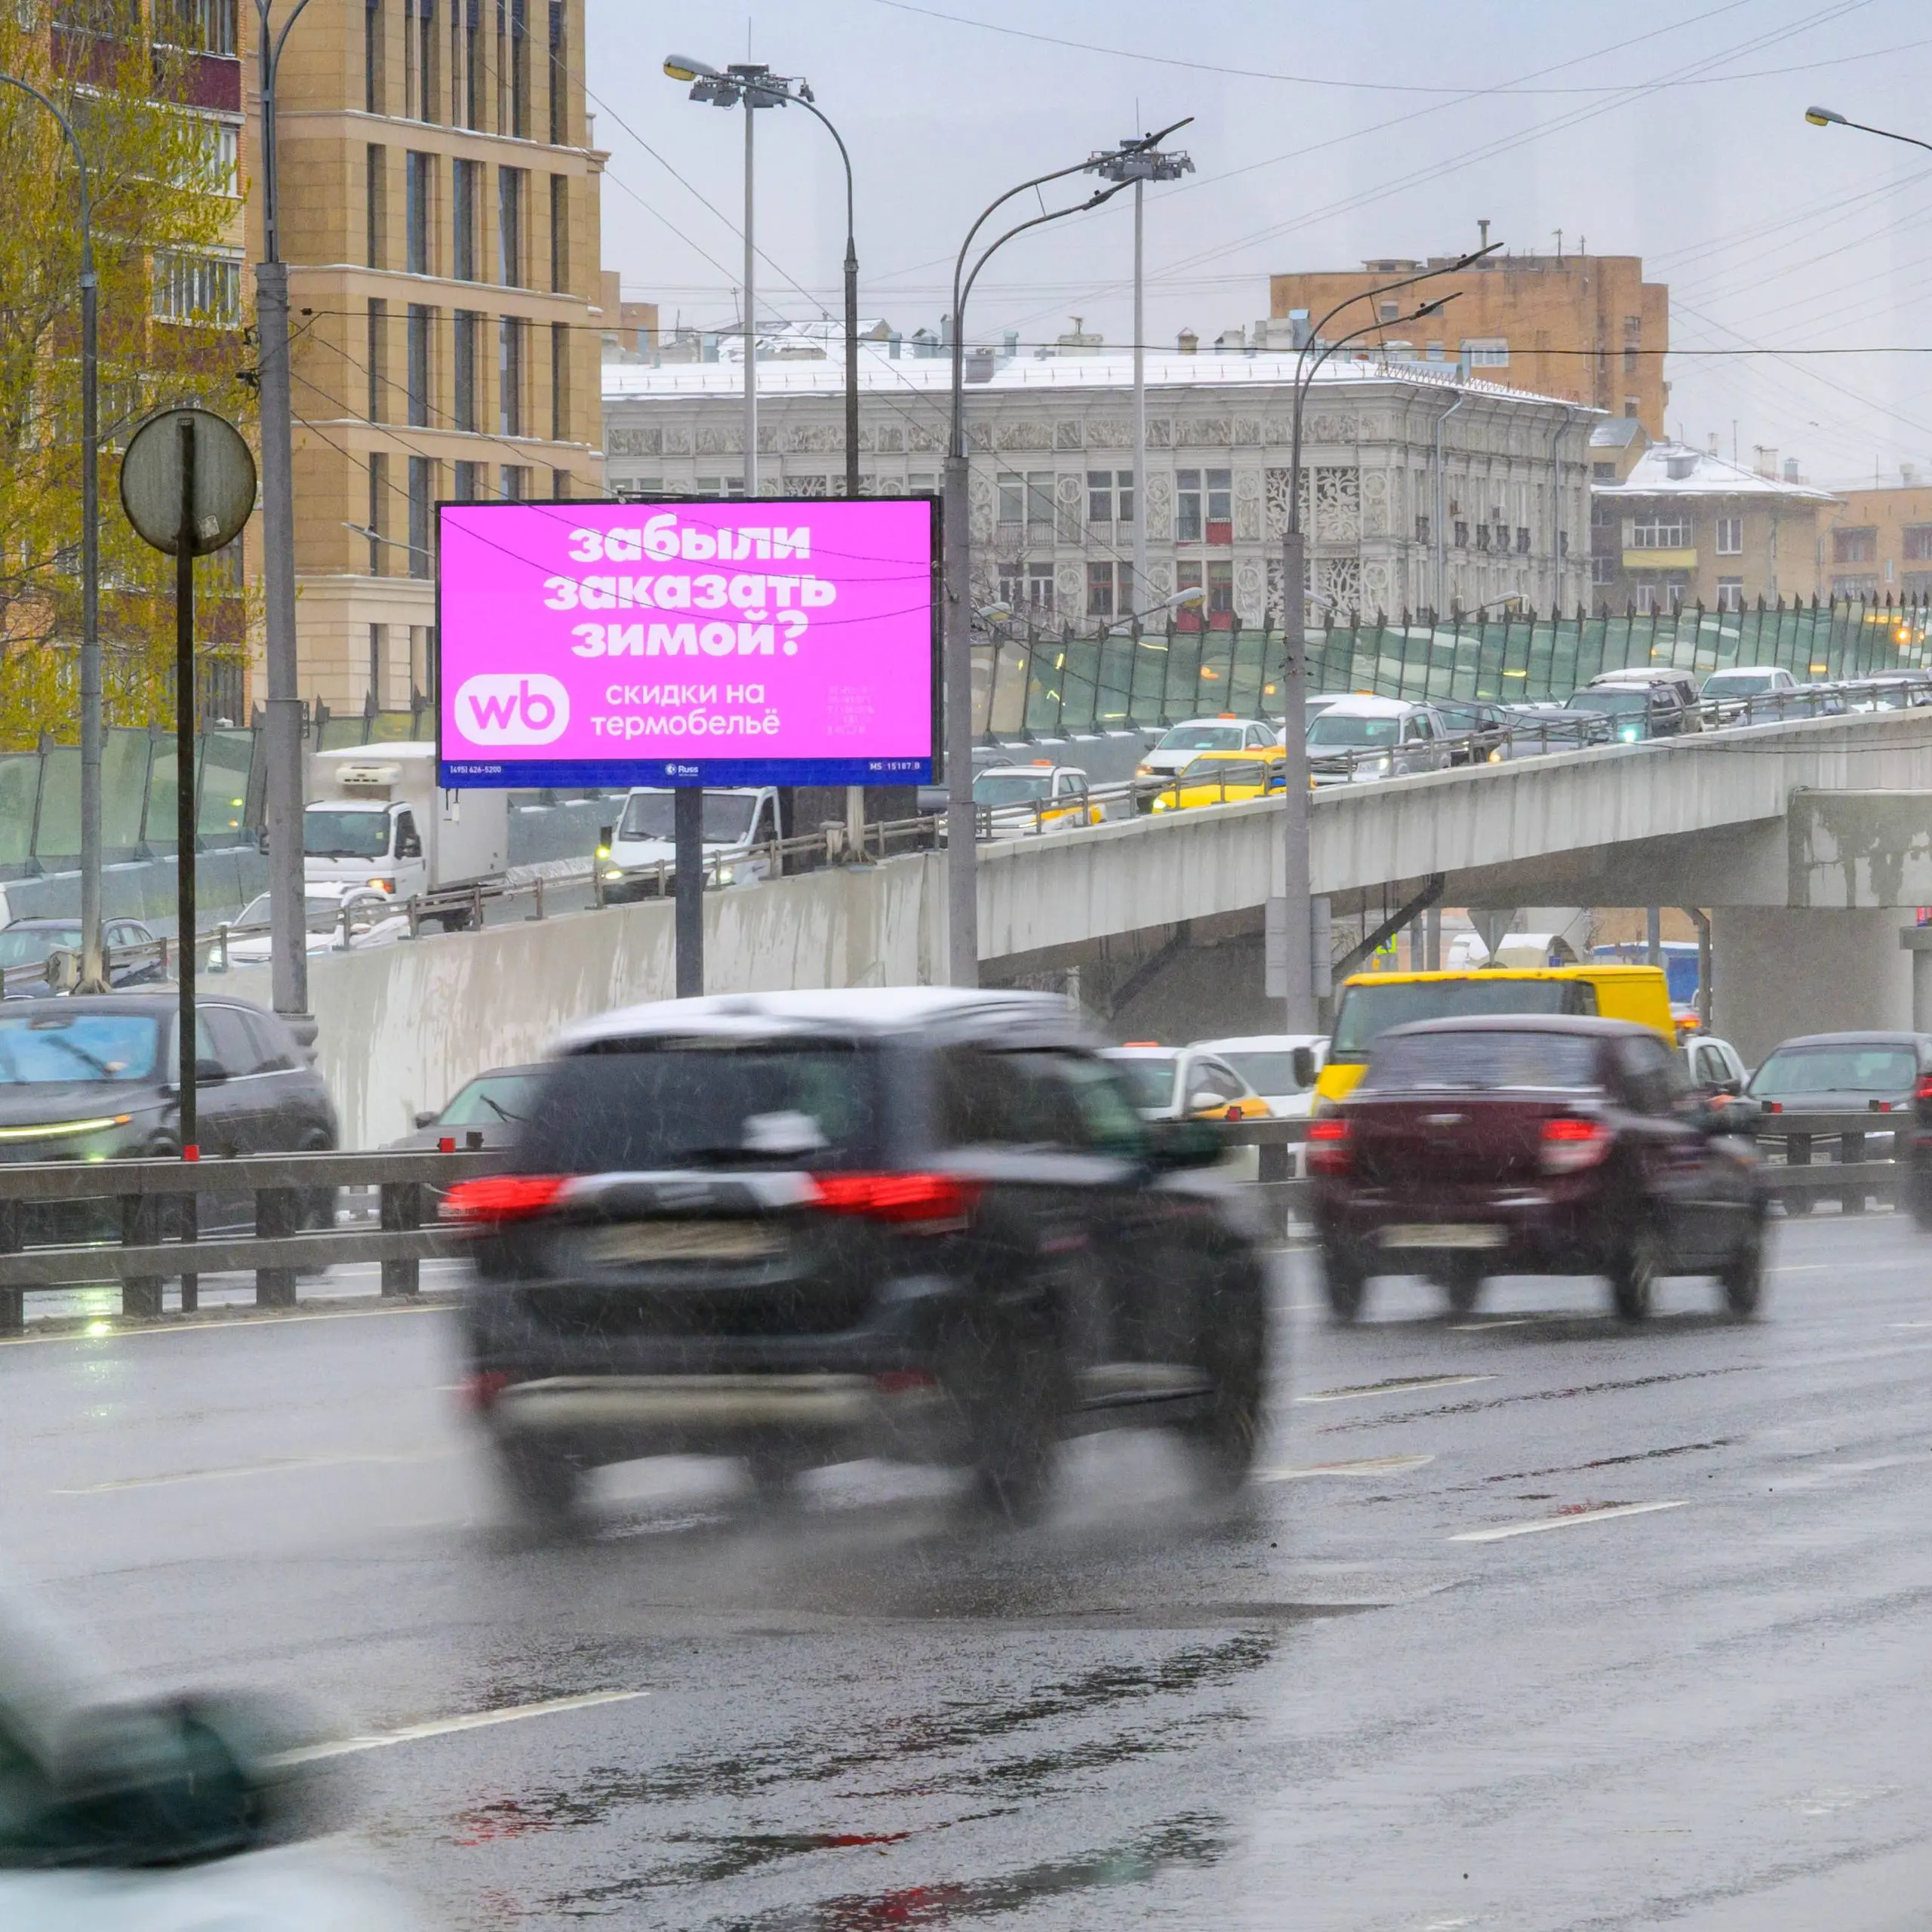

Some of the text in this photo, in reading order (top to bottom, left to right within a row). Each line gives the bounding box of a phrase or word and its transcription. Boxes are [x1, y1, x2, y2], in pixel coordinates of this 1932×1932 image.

[568, 512, 811, 562] забыли
[543, 574, 837, 611] заказать
[571, 610, 809, 657] зимой?
[467, 679, 556, 731] wb
[606, 684, 765, 708] скидки на
[590, 708, 780, 740] термобельё
[678, 764, 699, 774] Russ
